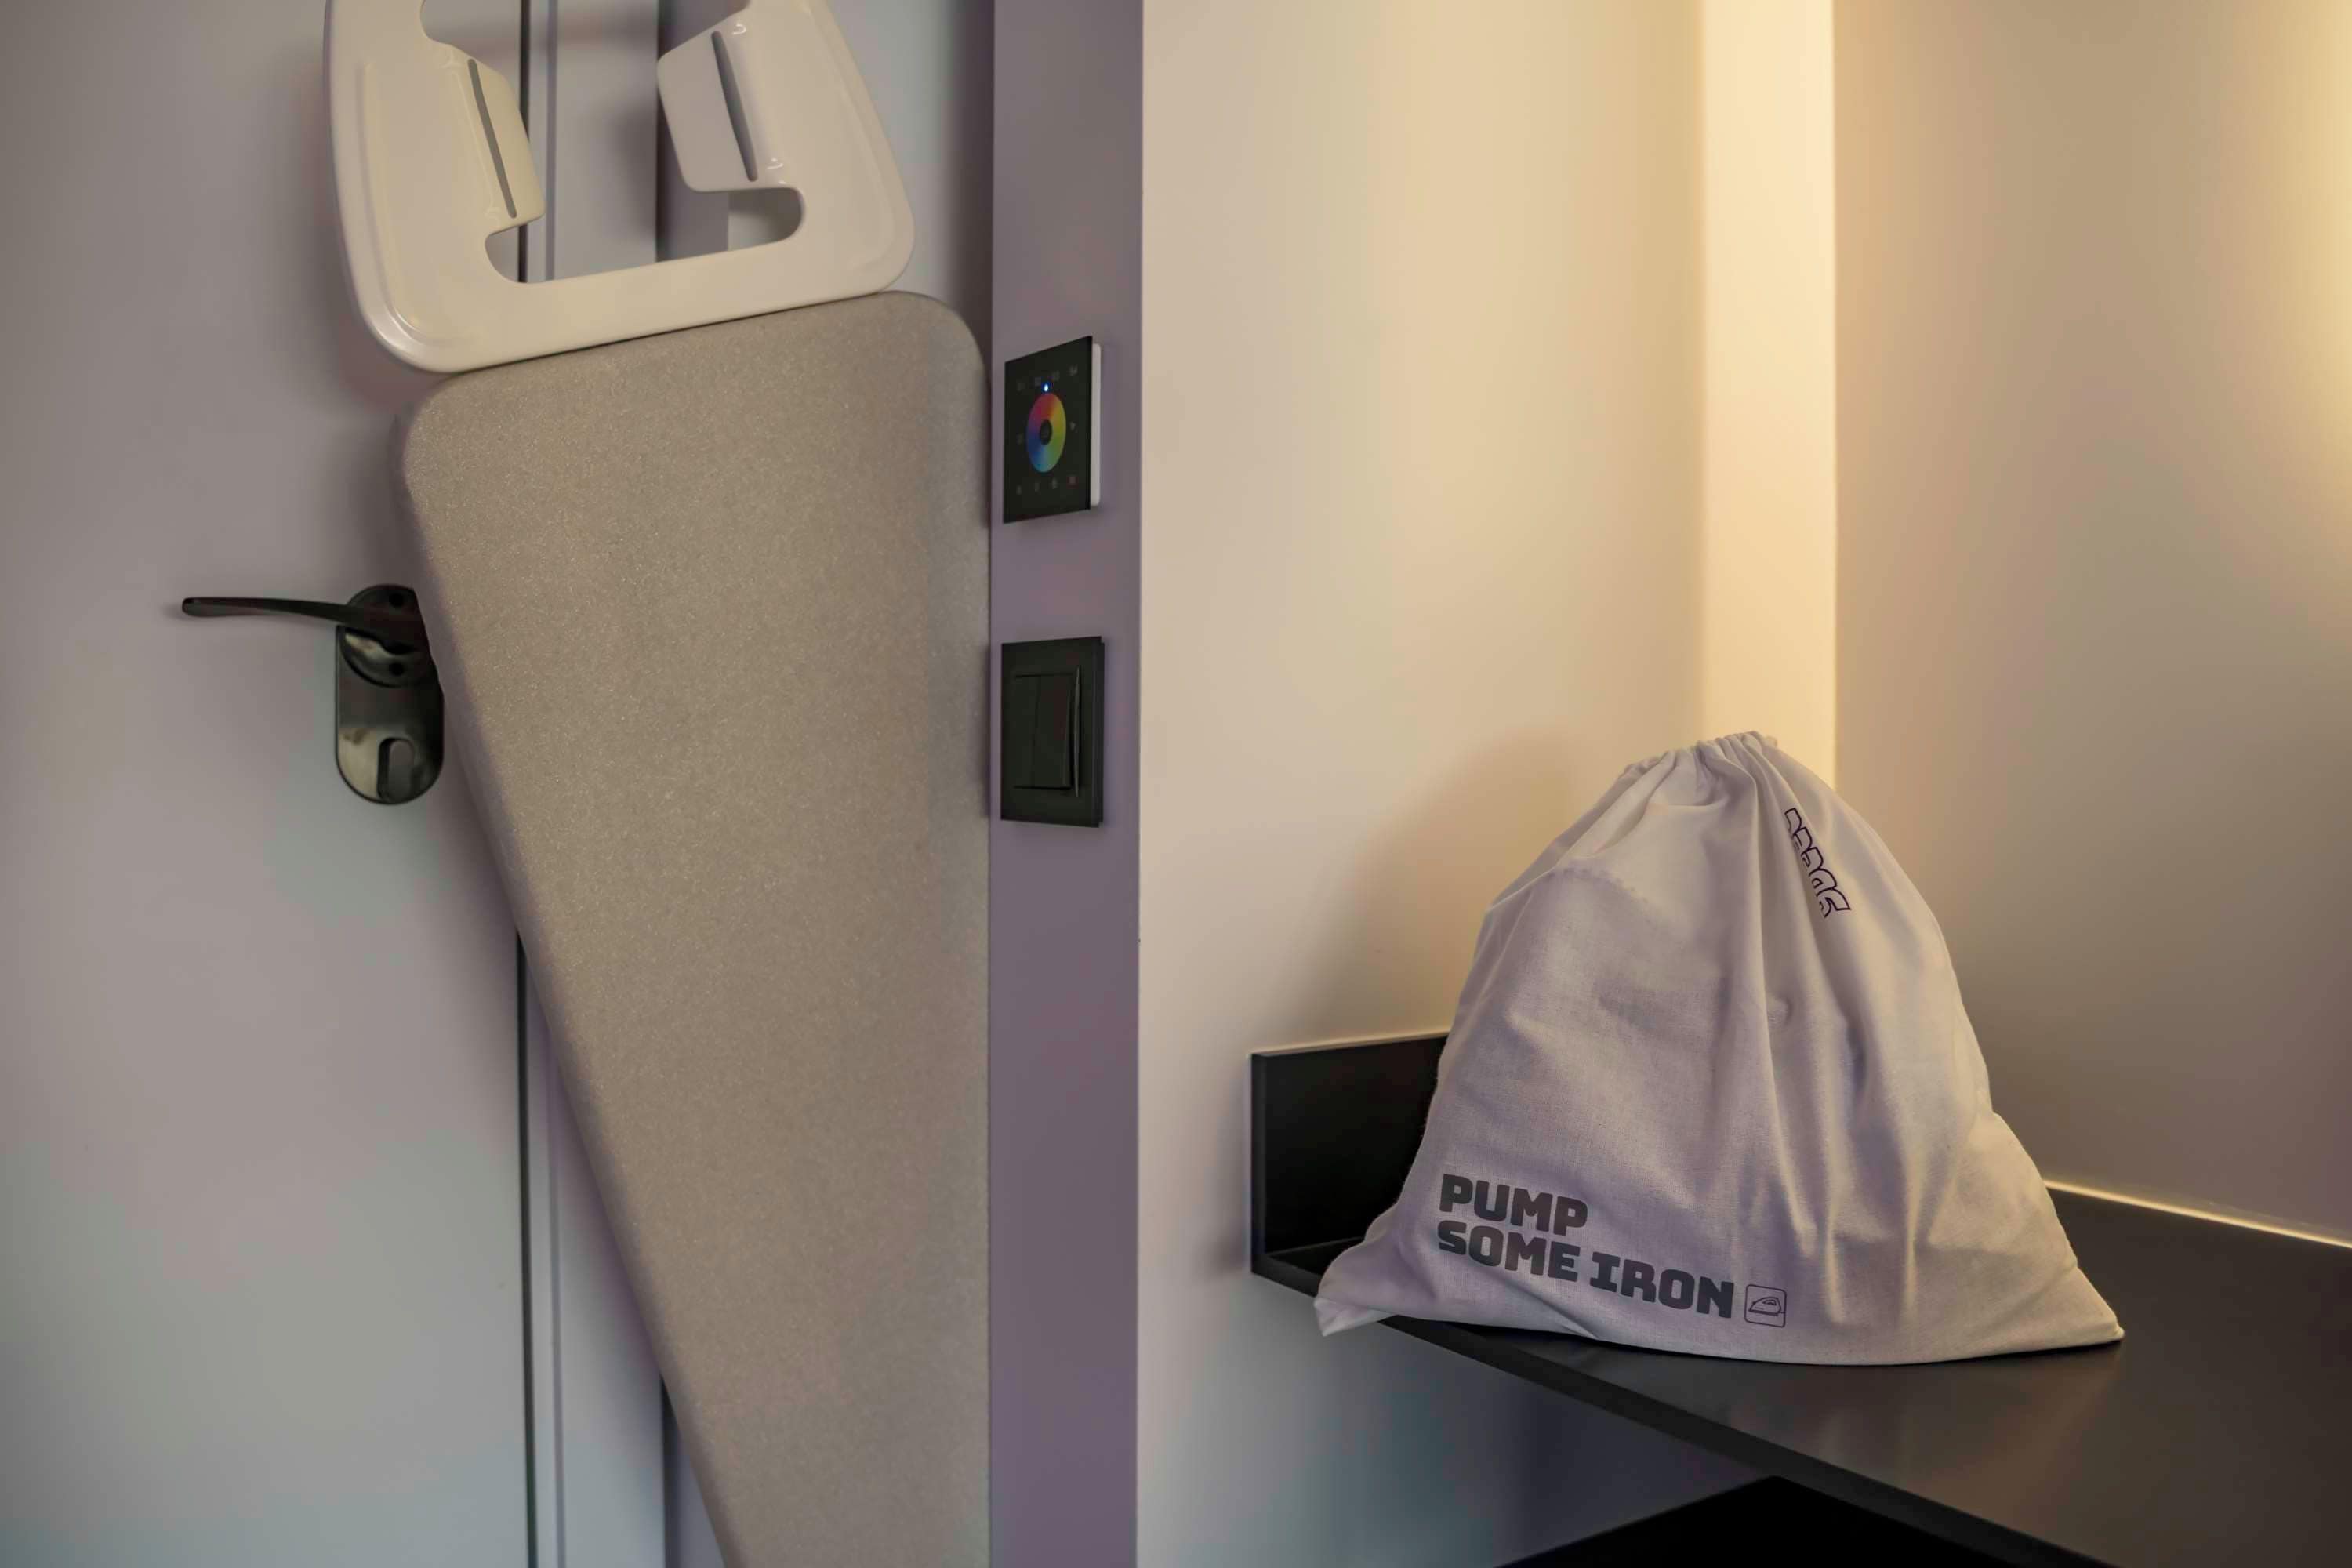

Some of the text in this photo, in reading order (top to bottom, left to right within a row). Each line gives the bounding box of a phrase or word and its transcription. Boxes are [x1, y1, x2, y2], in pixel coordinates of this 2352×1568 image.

[1439, 1174, 1588, 1236] PUMP
[1437, 1220, 1734, 1318] SOME IRON
